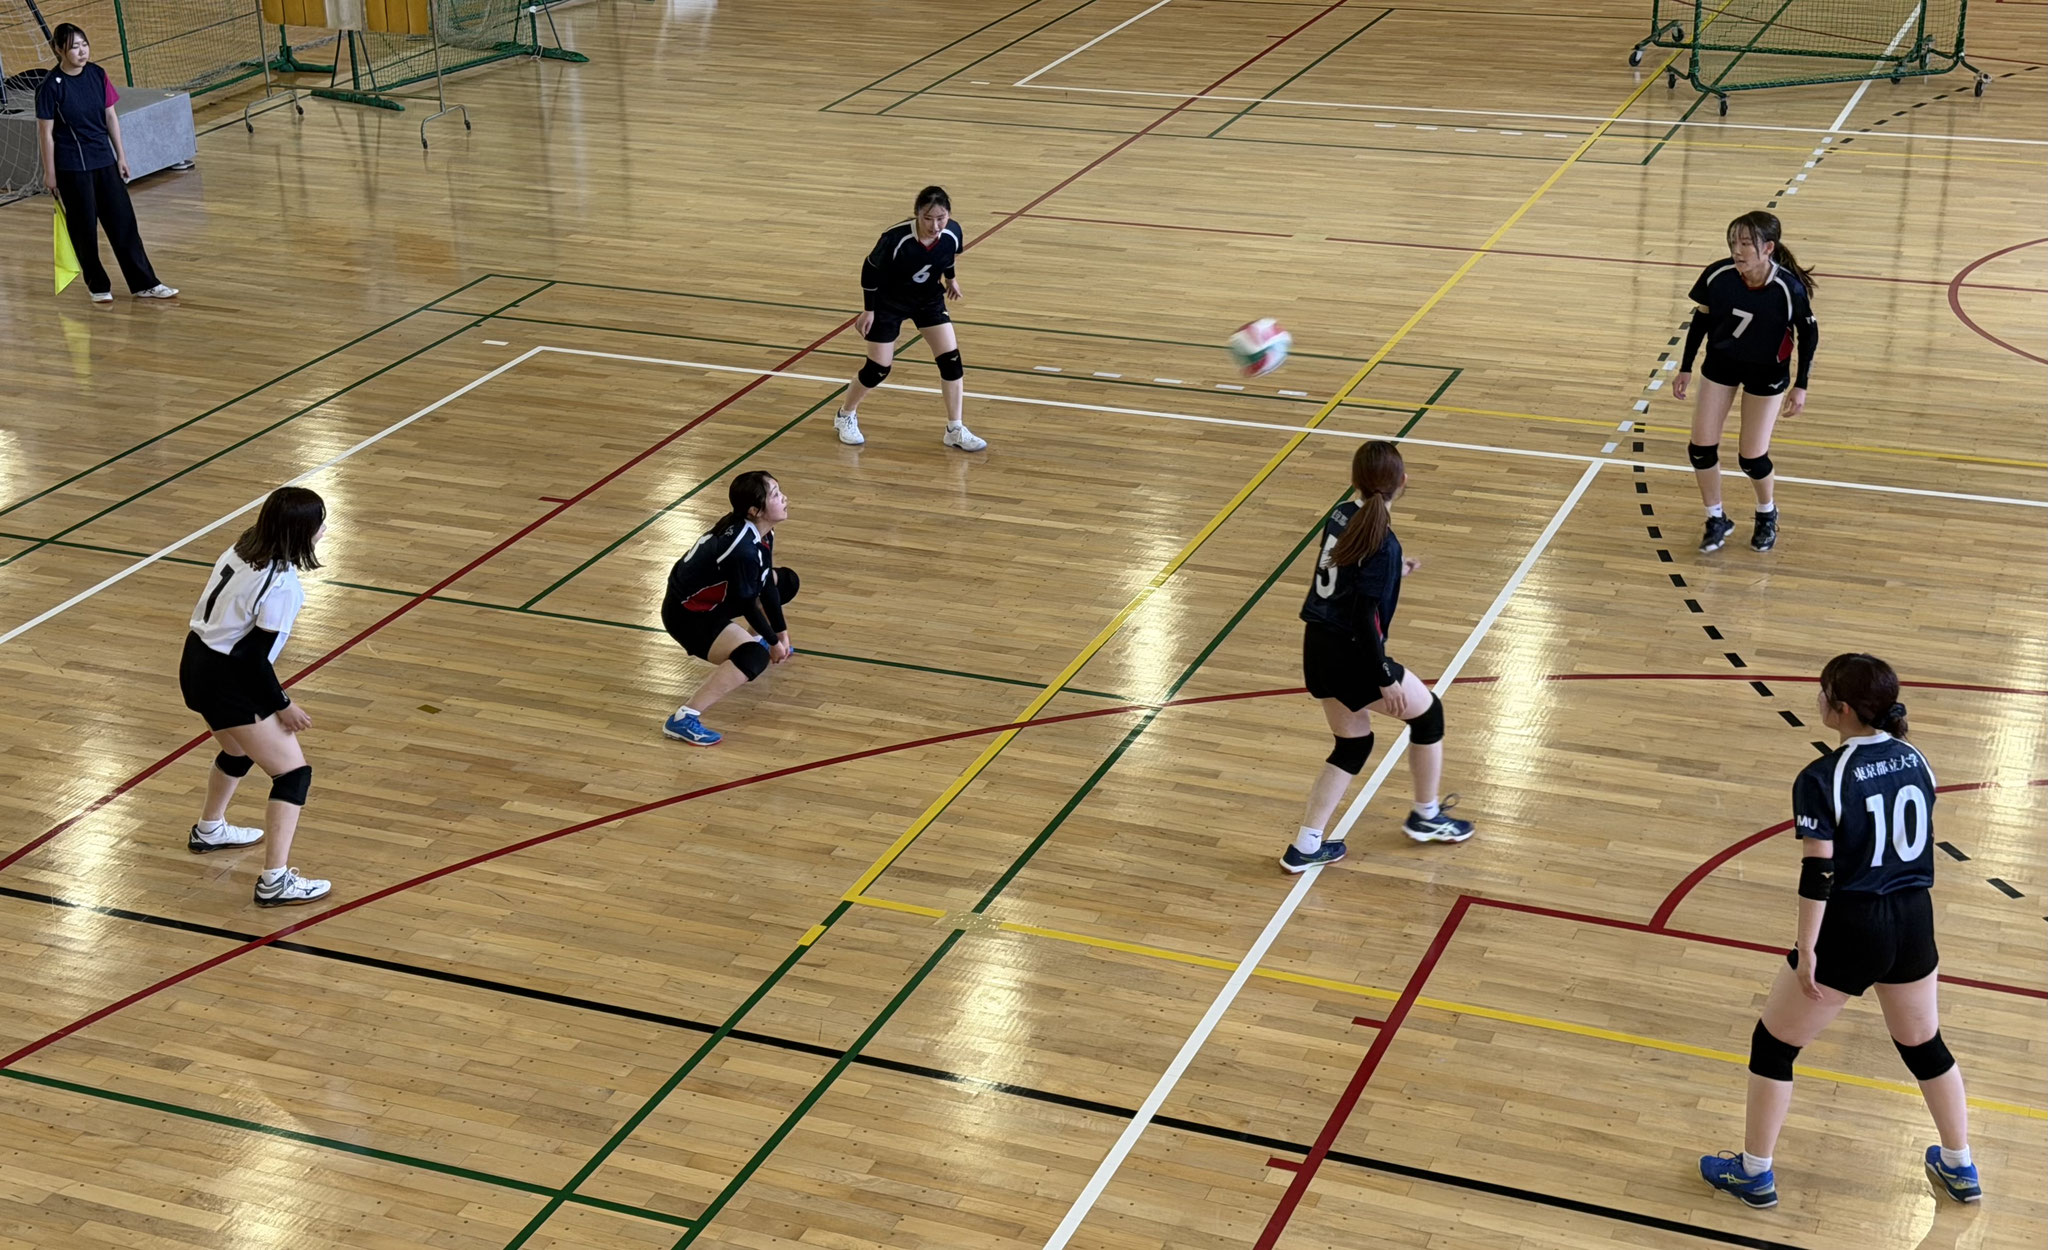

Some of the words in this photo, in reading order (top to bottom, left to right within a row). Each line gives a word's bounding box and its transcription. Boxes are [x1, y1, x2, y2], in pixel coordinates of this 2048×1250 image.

[912, 264, 932, 283] 6
[1732, 308, 1753, 339] 7
[203, 563, 235, 624] 1
[1853, 753, 1919, 782] 東京都立大学
[1865, 784, 1928, 868] 10
